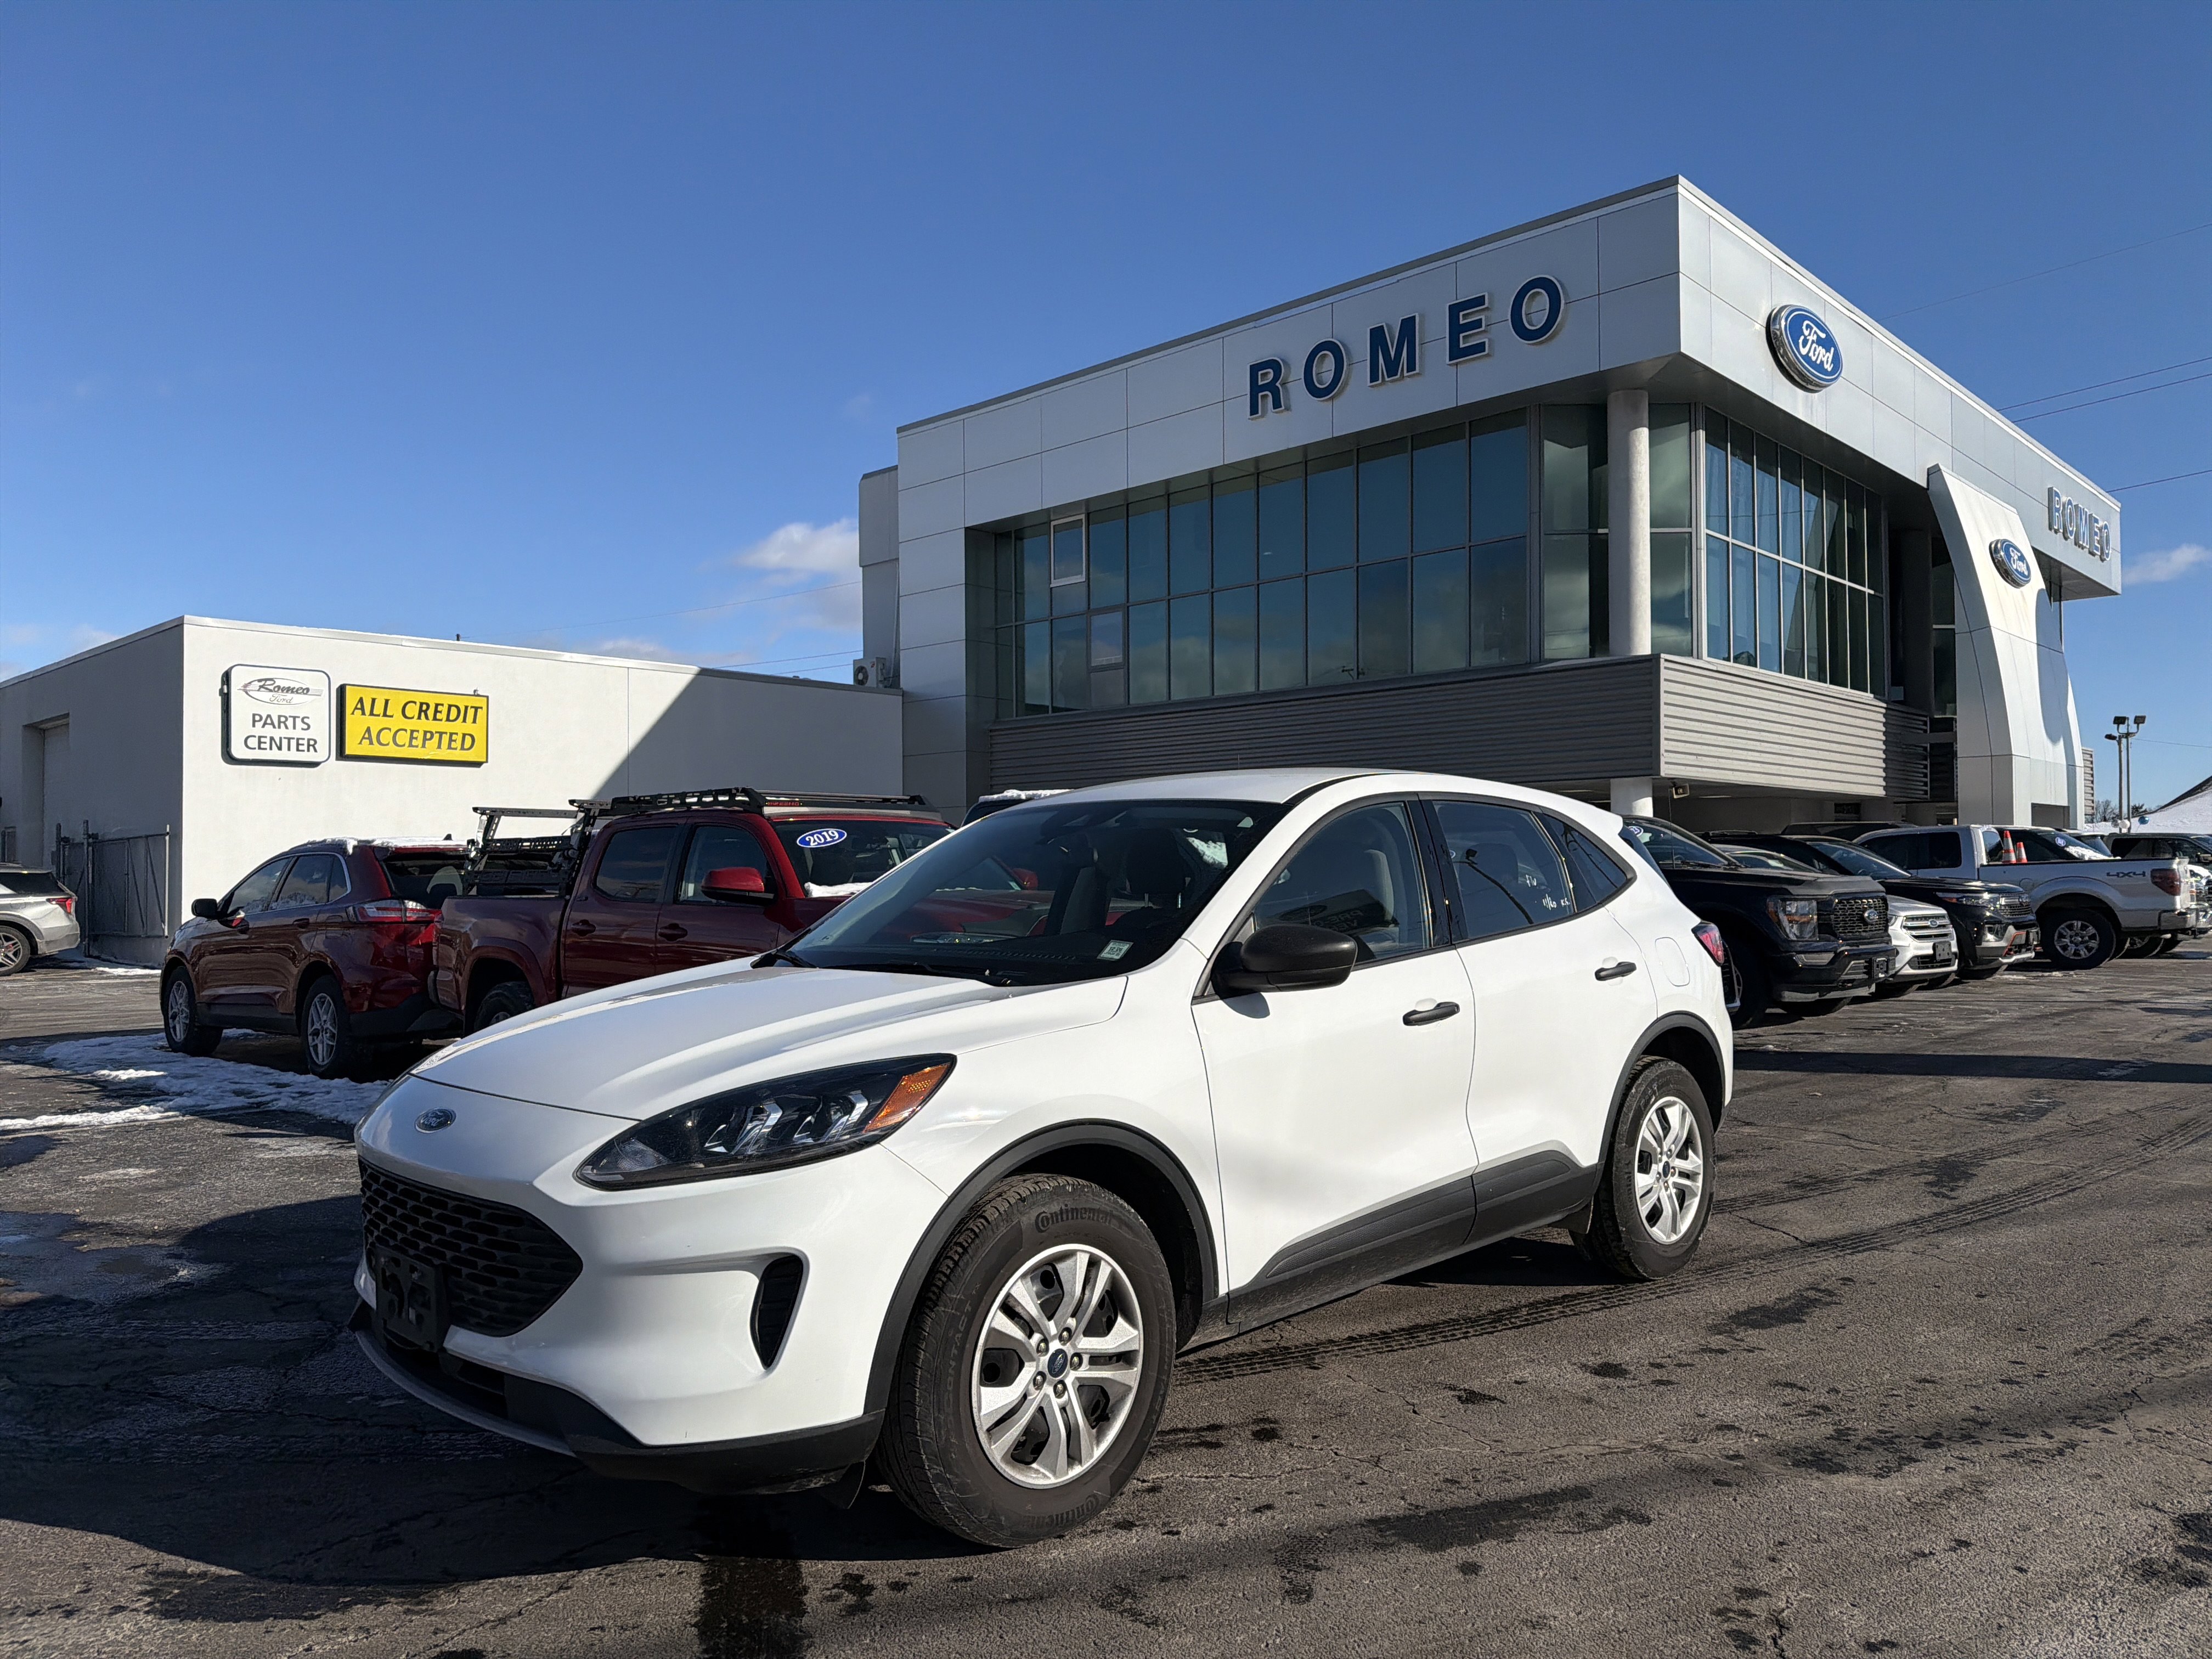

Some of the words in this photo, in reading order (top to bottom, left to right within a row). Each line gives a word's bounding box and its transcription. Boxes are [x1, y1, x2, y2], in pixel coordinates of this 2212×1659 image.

[1248, 275, 1566, 420] ROMEO
[1798, 320, 1835, 372] Ford
[2049, 487, 2111, 561] ROMEO
[2010, 547, 2028, 576] Ford
[257, 678, 311, 695] Romeo
[269, 693, 294, 703] Ford
[251, 713, 311, 731] PARTS
[350, 696, 394, 719] ALL
[401, 700, 483, 725] CREDIT
[244, 734, 318, 753] CENTER
[358, 726, 476, 752] ACCEPTED
[805, 830, 839, 845] 2019
[420, 1110, 444, 1127] Ford
[1035, 1203, 1114, 1233] Continental
